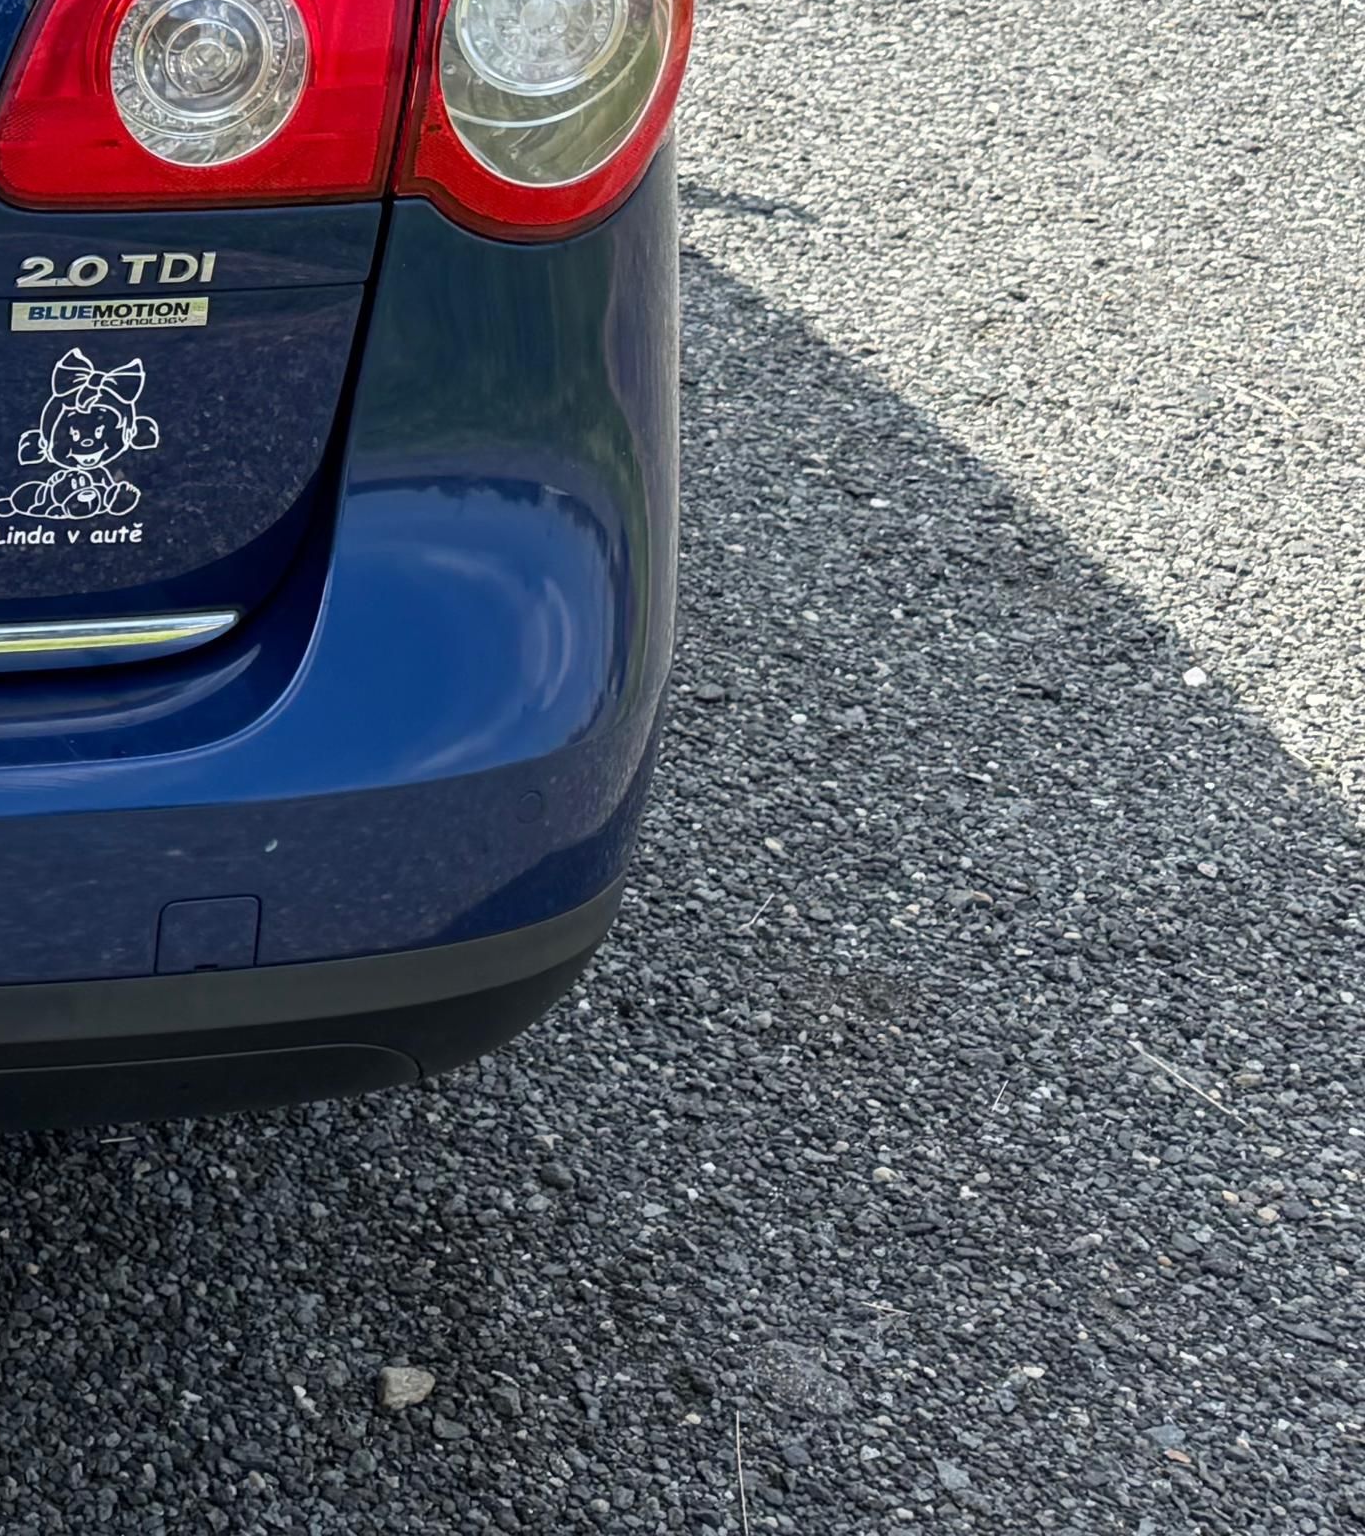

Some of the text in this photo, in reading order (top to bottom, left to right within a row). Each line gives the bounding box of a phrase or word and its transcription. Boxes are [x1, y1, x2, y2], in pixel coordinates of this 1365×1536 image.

[16, 251, 216, 288] 2.0 TDI
[28, 302, 190, 321] BLUEMOTION
[91, 316, 188, 328] TECHNOLOGY
[67, 530, 80, 544] v
[90, 522, 143, 544] autě
